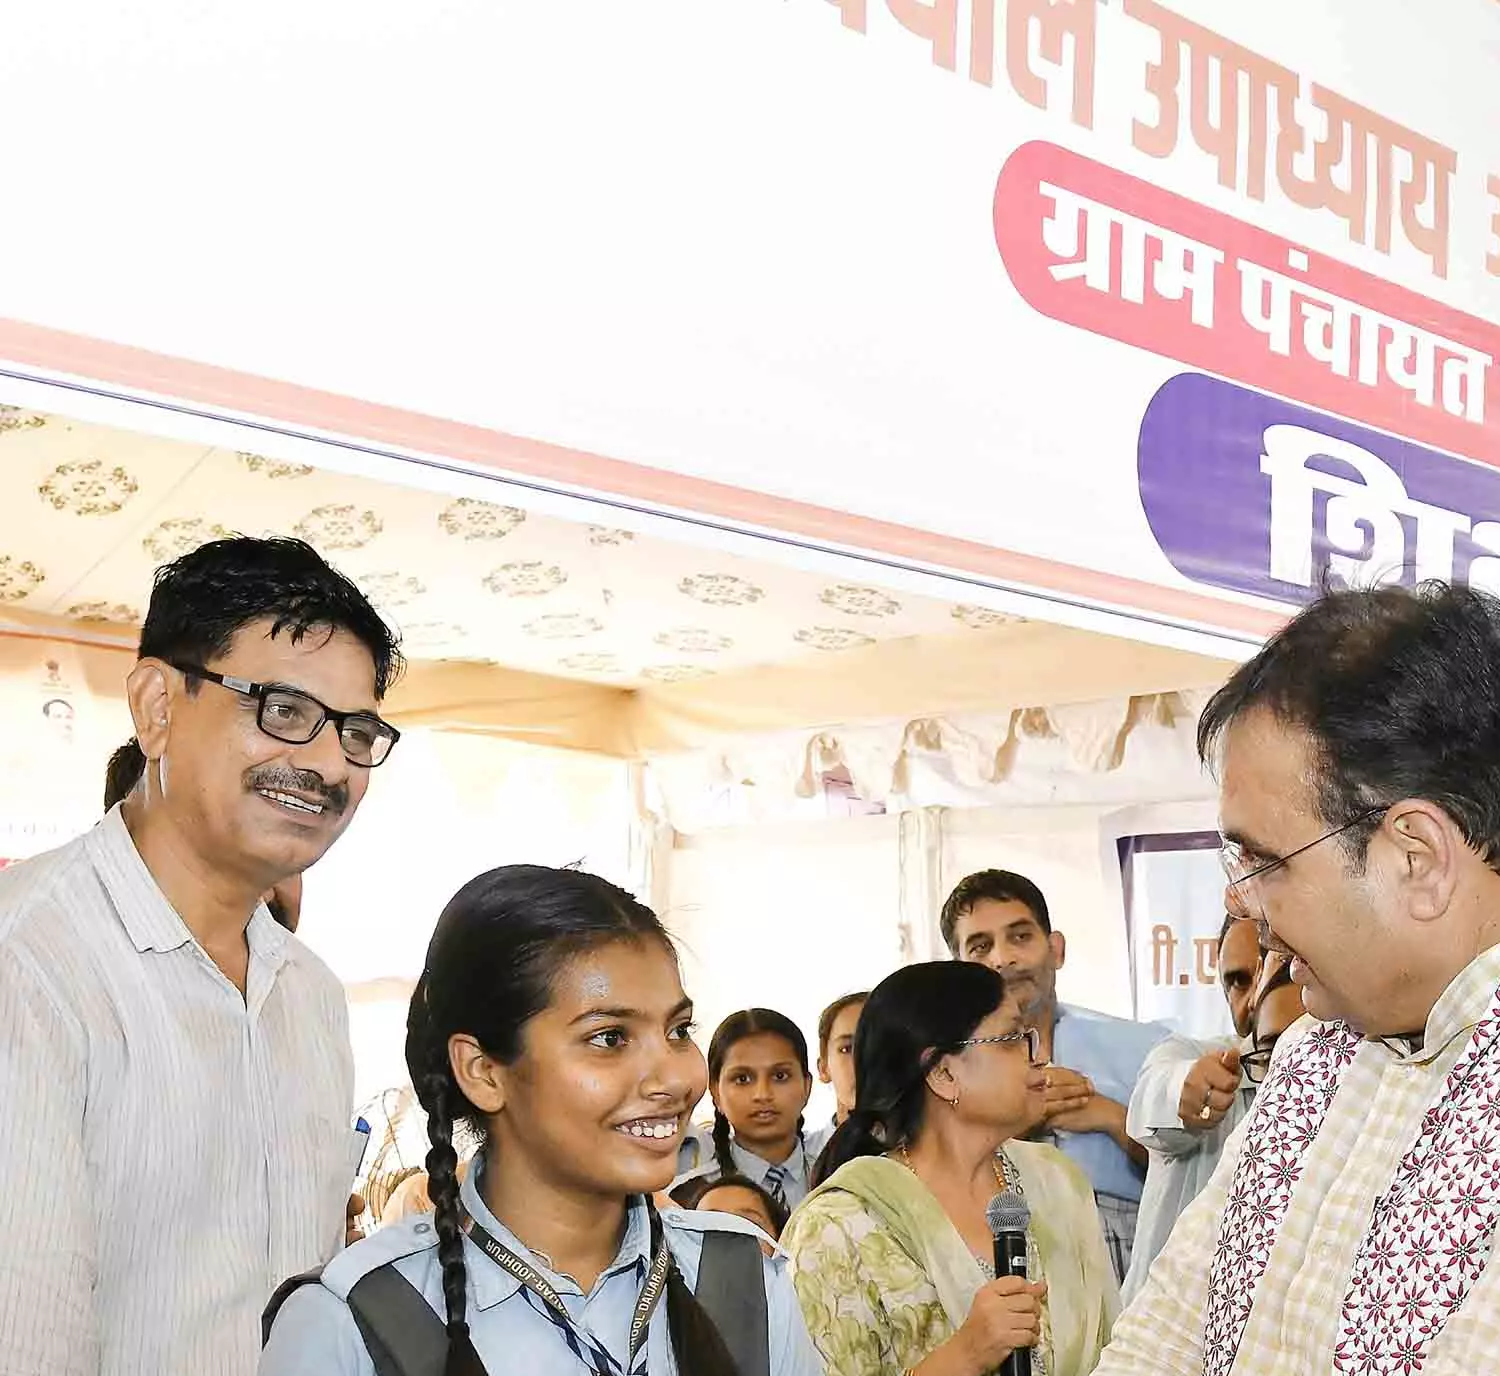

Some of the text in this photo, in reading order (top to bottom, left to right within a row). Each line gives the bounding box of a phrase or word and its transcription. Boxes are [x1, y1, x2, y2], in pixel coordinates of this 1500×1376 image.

[1124, 0, 1458, 280] उपाध्याय
[1037, 180, 1224, 329] ग्राम
[1237, 248, 1492, 425] पंचायत
